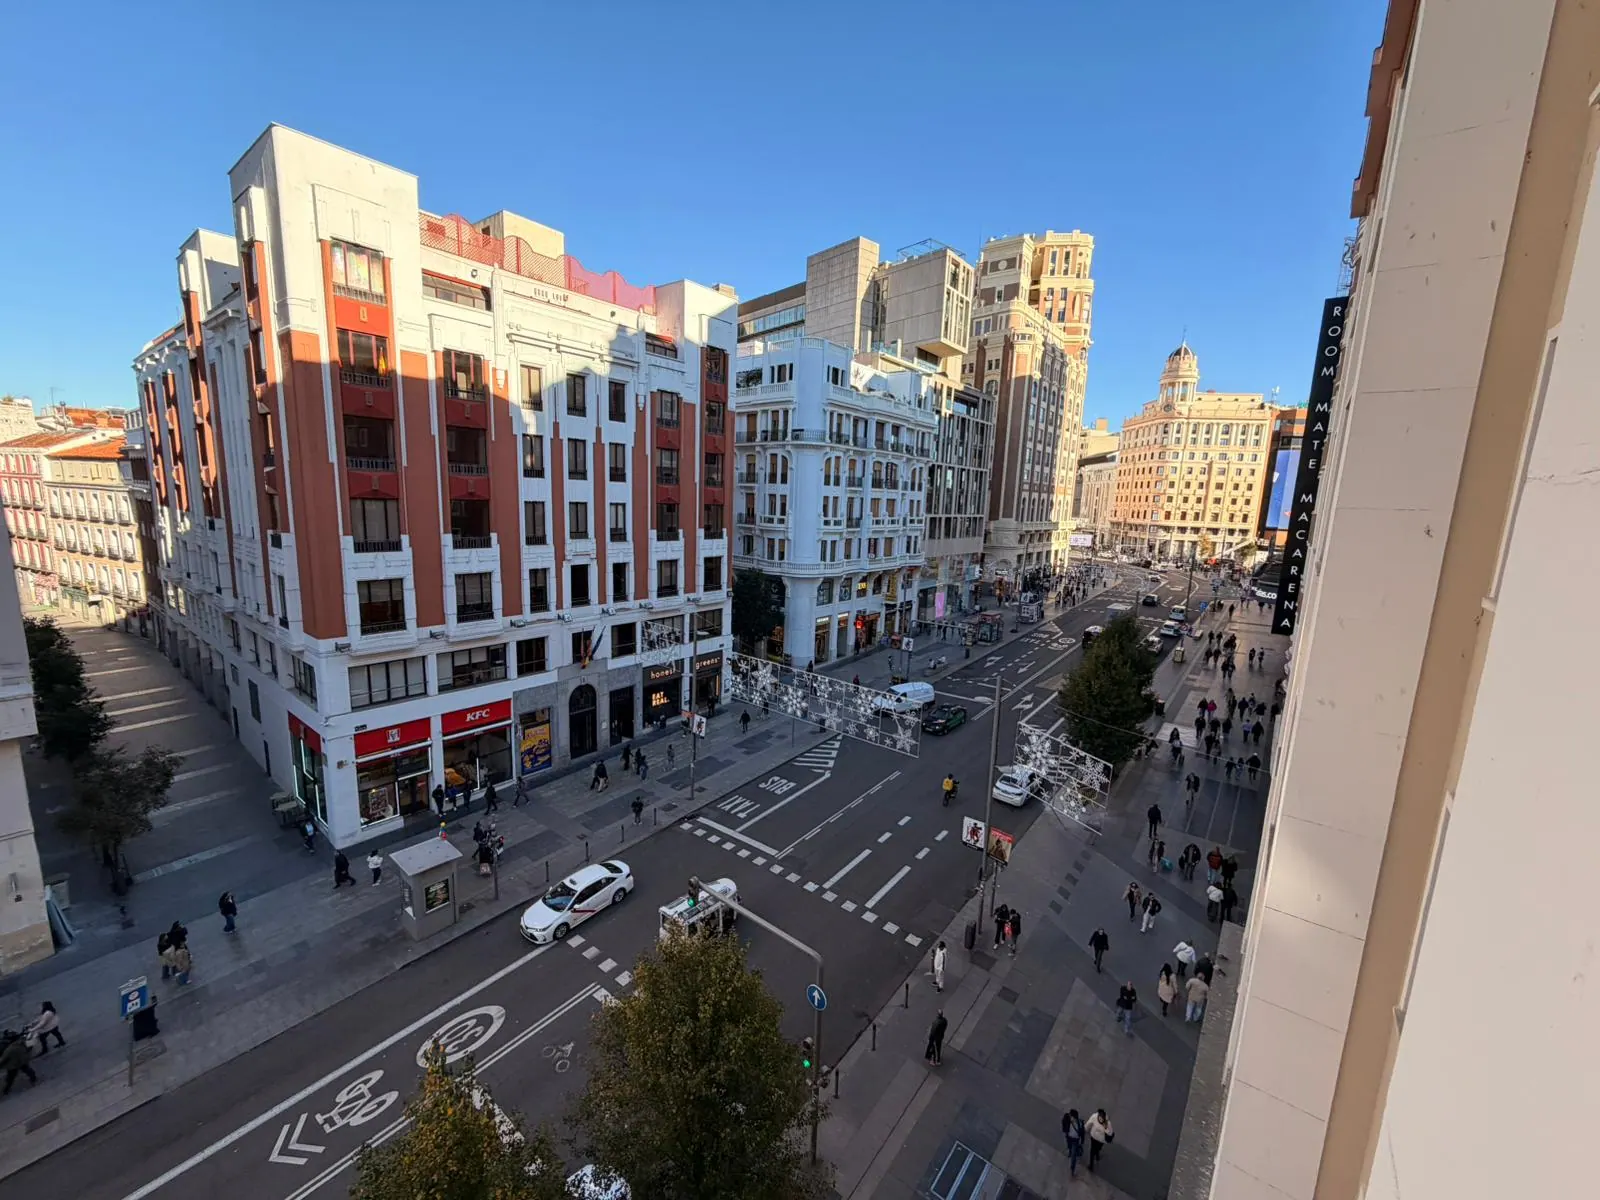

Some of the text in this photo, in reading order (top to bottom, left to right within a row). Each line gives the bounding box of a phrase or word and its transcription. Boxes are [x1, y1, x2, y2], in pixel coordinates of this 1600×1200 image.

[1280, 306, 1342, 628] ROOM MATE MACARENA
[652, 691, 664, 700] EAT
[466, 708, 490, 722] KFC
[758, 776, 797, 795] BUS
[717, 795, 760, 818] TAXI
[438, 1018, 485, 1053] 30
